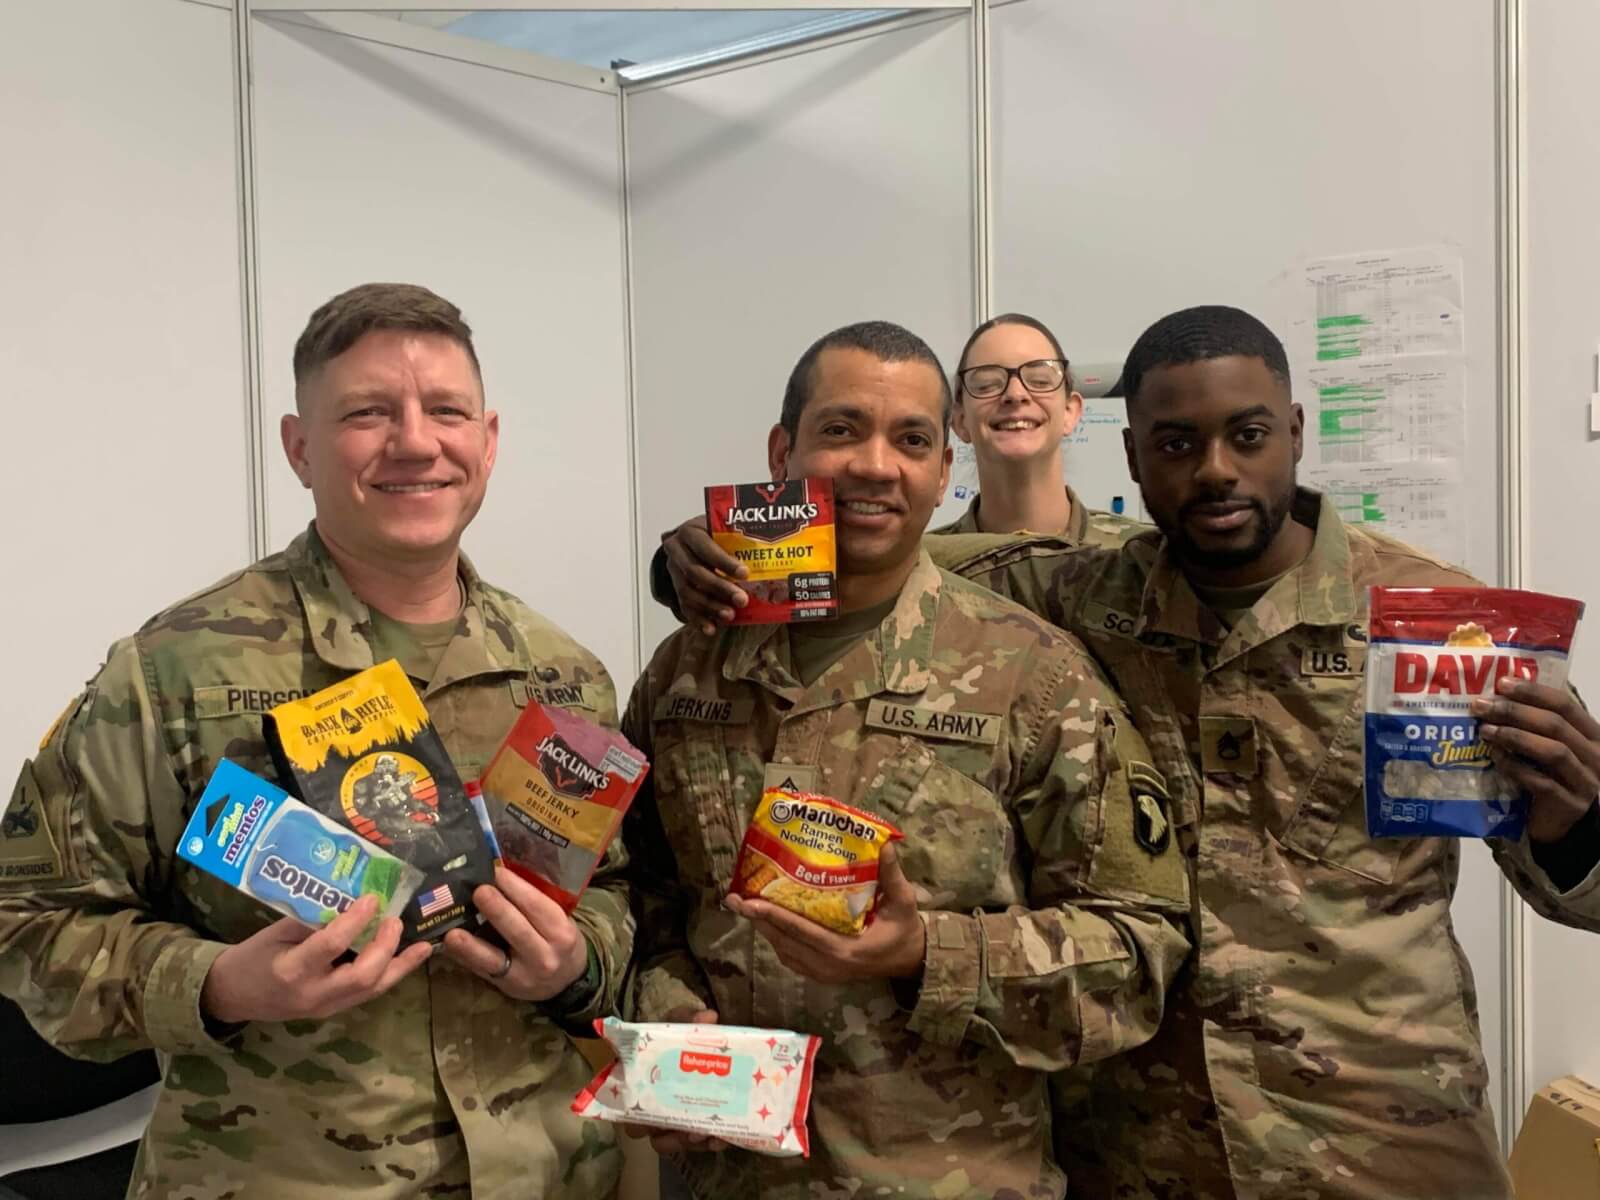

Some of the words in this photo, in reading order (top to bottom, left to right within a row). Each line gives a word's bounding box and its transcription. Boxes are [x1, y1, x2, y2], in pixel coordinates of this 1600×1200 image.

[726, 507, 767, 525] JACK
[736, 548, 774, 561] SWEET
[775, 547, 784, 559] &
[787, 546, 813, 558] HOT
[794, 577, 809, 589] 6g
[795, 591, 810, 600] 50
[1312, 652, 1352, 672] U.S.
[1394, 652, 1538, 695] DAVID
[300, 714, 341, 738] BLACK
[354, 695, 394, 720] RIFLE
[666, 698, 733, 720] JERKINS
[881, 706, 918, 729] U.S.
[926, 713, 988, 737] ARMY
[1404, 724, 1475, 740] ORIGI
[536, 736, 569, 769] JACK
[1432, 740, 1489, 765] Jumb
[525, 779, 548, 801] BEEF
[548, 795, 581, 819] JERKY
[525, 797, 562, 826] ORIGINAL
[223, 795, 266, 865] mentos
[791, 803, 876, 841] Maruchan
[800, 823, 844, 844] Ramen
[780, 828, 825, 851] Noodle
[827, 843, 857, 862] Soup
[795, 864, 827, 884] Beef
